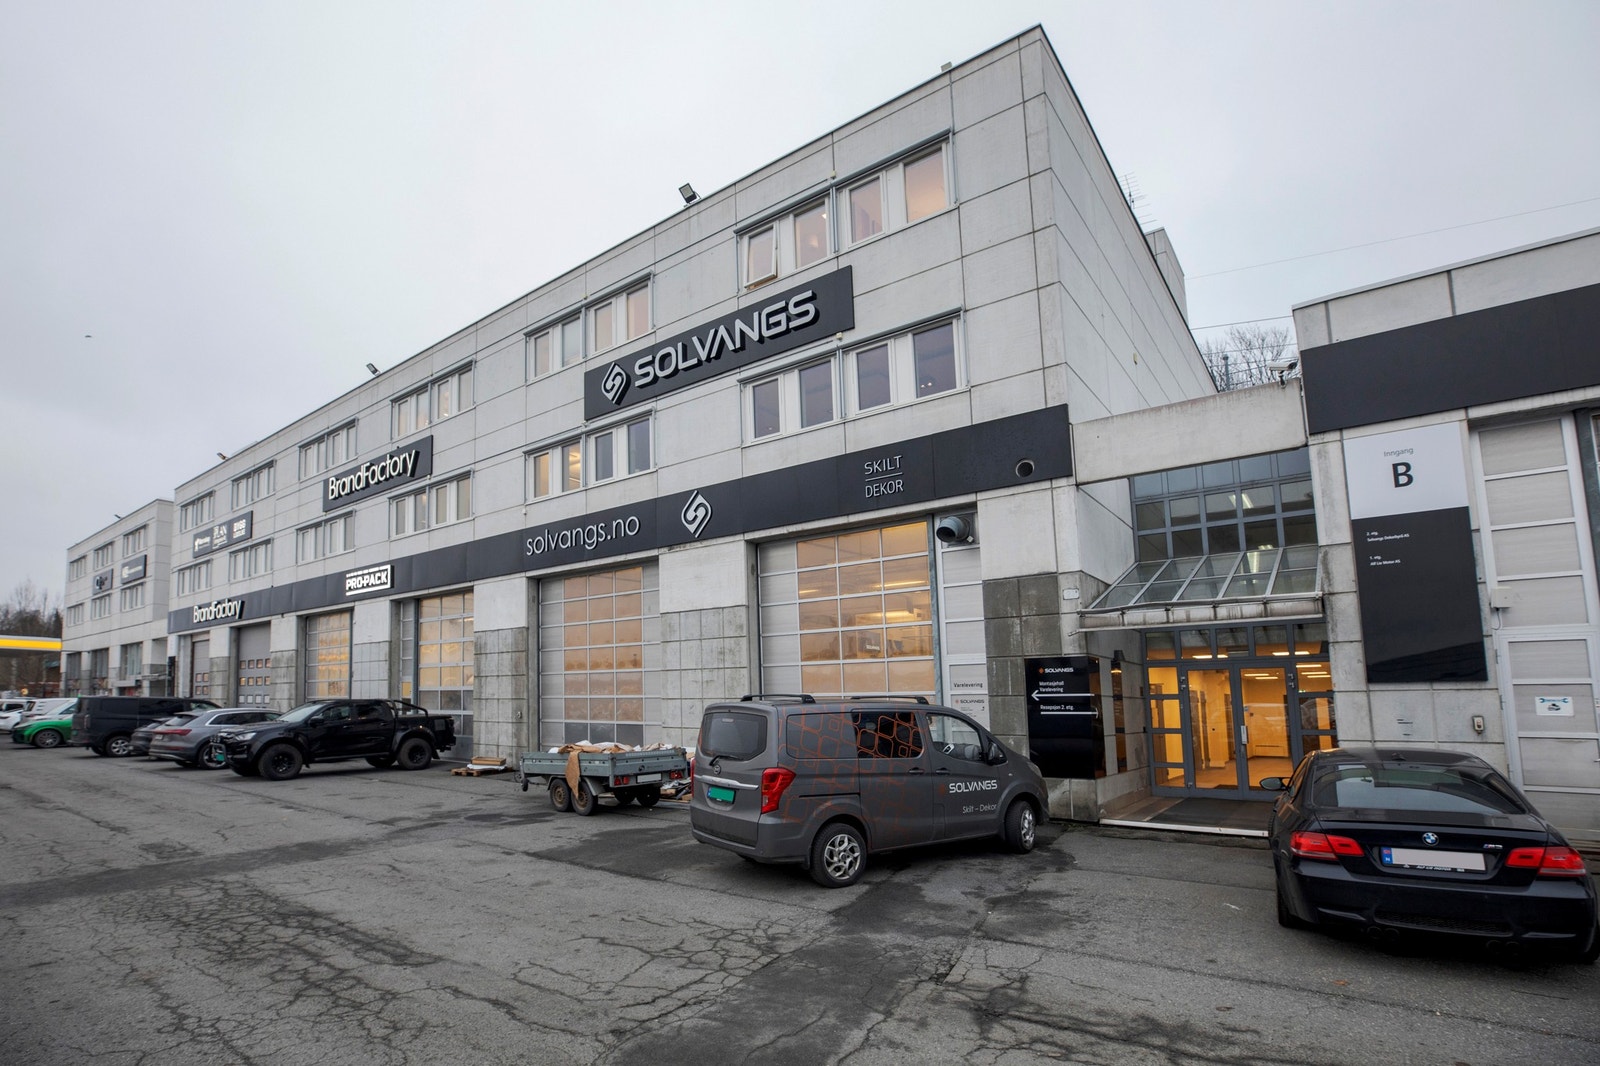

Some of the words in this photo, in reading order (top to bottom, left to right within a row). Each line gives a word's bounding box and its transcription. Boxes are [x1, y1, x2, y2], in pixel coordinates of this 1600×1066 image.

[634, 290, 817, 388] SOLVANGS
[1383, 447, 1414, 457] Inngang
[328, 450, 417, 500] BrandFactory
[864, 455, 902, 475] SKILT
[1391, 461, 1414, 488] B
[865, 479, 904, 498] DEKOR
[526, 515, 640, 556] solvangs.no
[193, 598, 242, 623] BrandFactory
[949, 780, 998, 793] SOLVANGS
[962, 805, 974, 814] Skilt
[979, 803, 997, 812] Dekor
